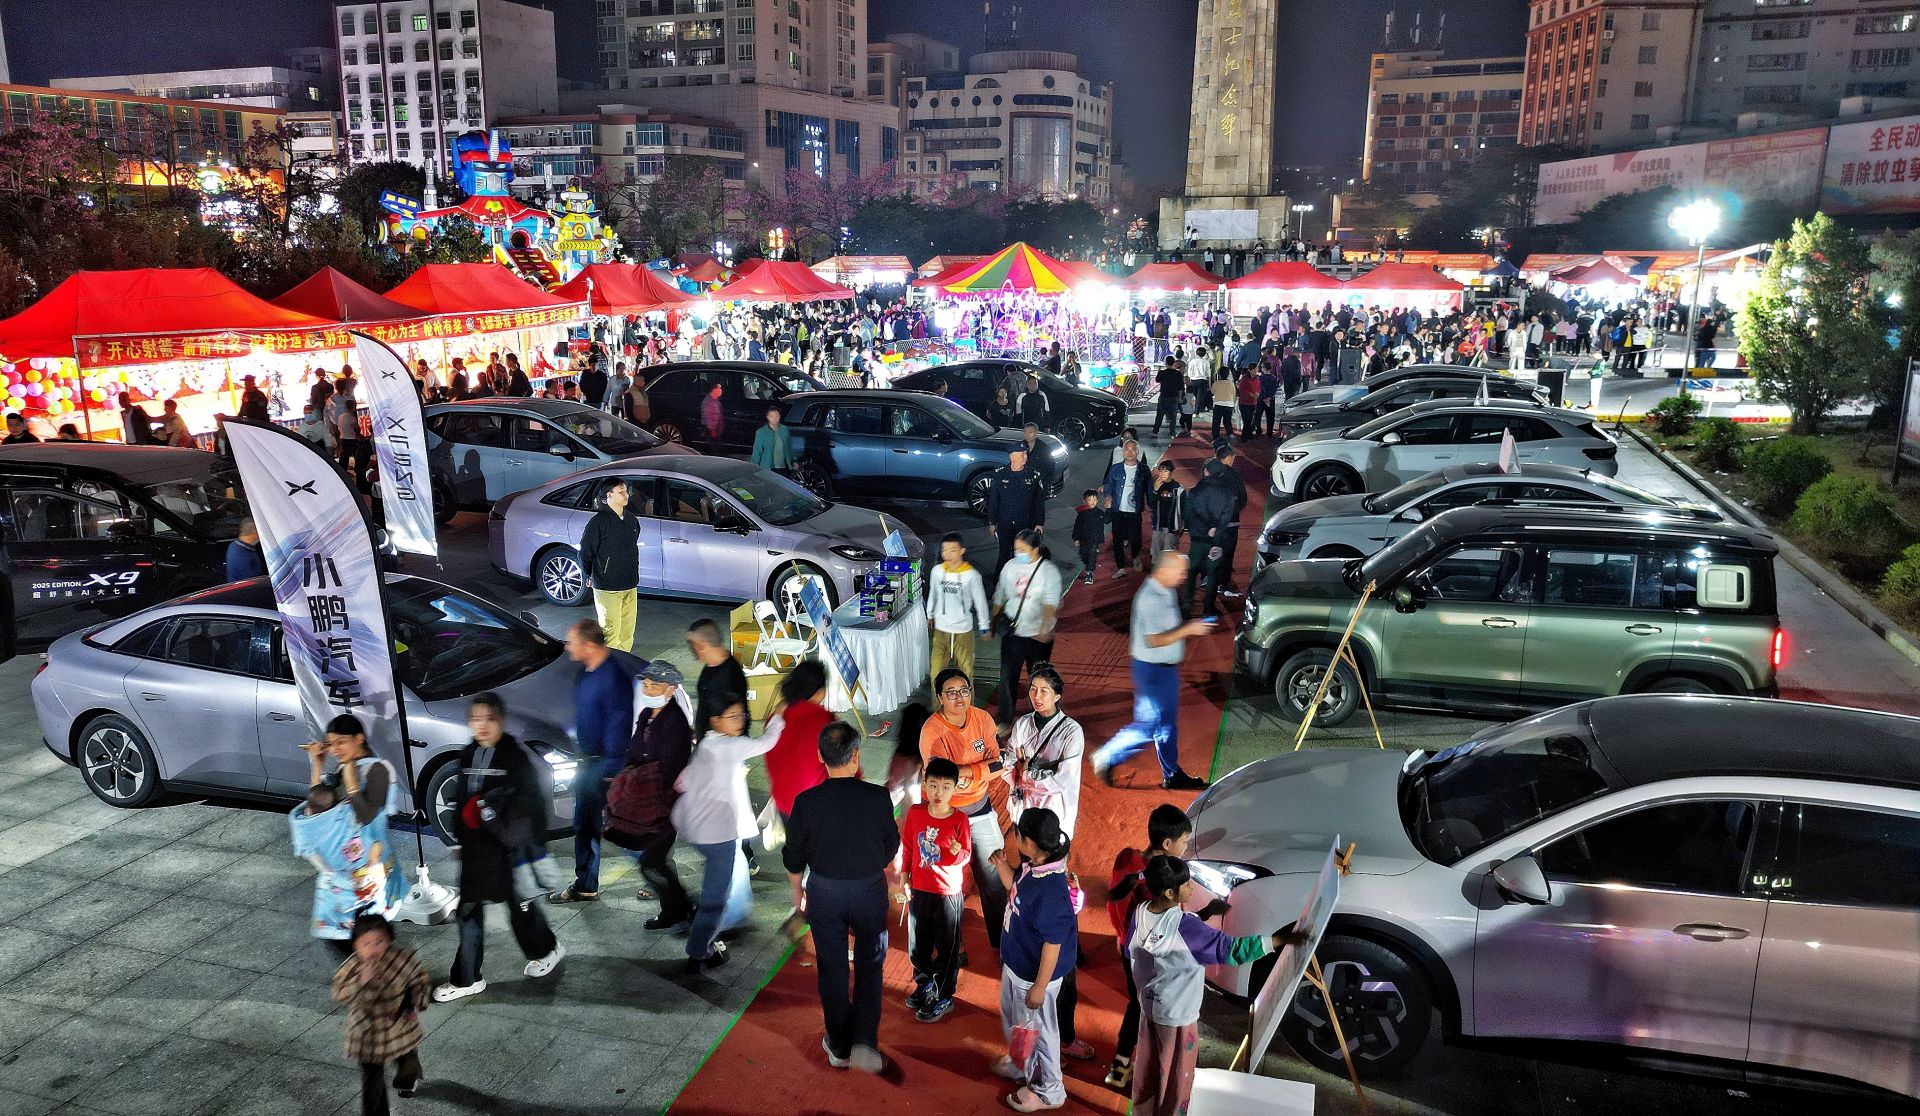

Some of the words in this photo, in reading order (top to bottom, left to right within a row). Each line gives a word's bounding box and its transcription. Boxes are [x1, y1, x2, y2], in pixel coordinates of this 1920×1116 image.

[107, 337, 174, 361] 开心射箭
[182, 332, 241, 356] 箭箭有奖
[374, 322, 418, 342] 开心为主
[423, 318, 463, 337] 枪枪有奖
[51, 581, 81, 589] EDITION
[82, 571, 140, 587] X9
[303, 552, 365, 714] 小鹏汽车
